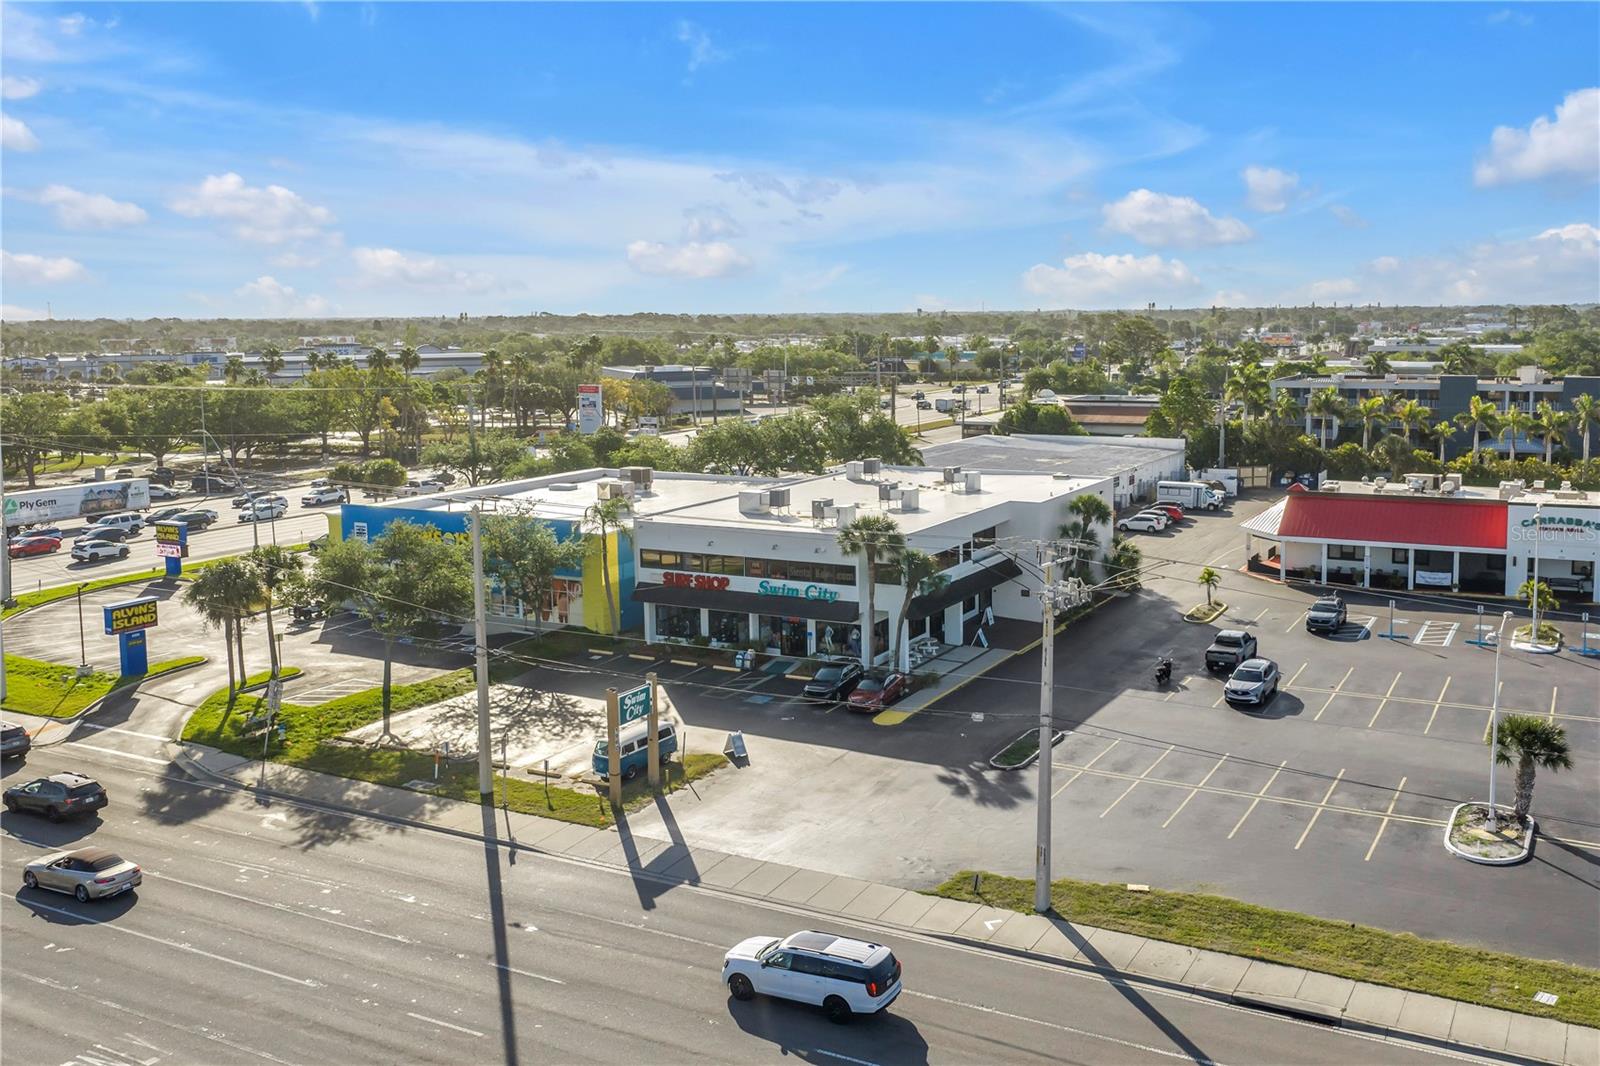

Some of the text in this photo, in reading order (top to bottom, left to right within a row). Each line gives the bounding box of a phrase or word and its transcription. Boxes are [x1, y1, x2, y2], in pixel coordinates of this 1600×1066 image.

[19, 499, 57, 511] Ply Gem
[694, 574, 730, 591] SHOP
[757, 580, 839, 604] Swim City
[112, 602, 156, 620] ALVIN'S
[112, 613, 156, 630] ISLAND
[623, 691, 647, 710] Swim
[626, 704, 644, 720] City
